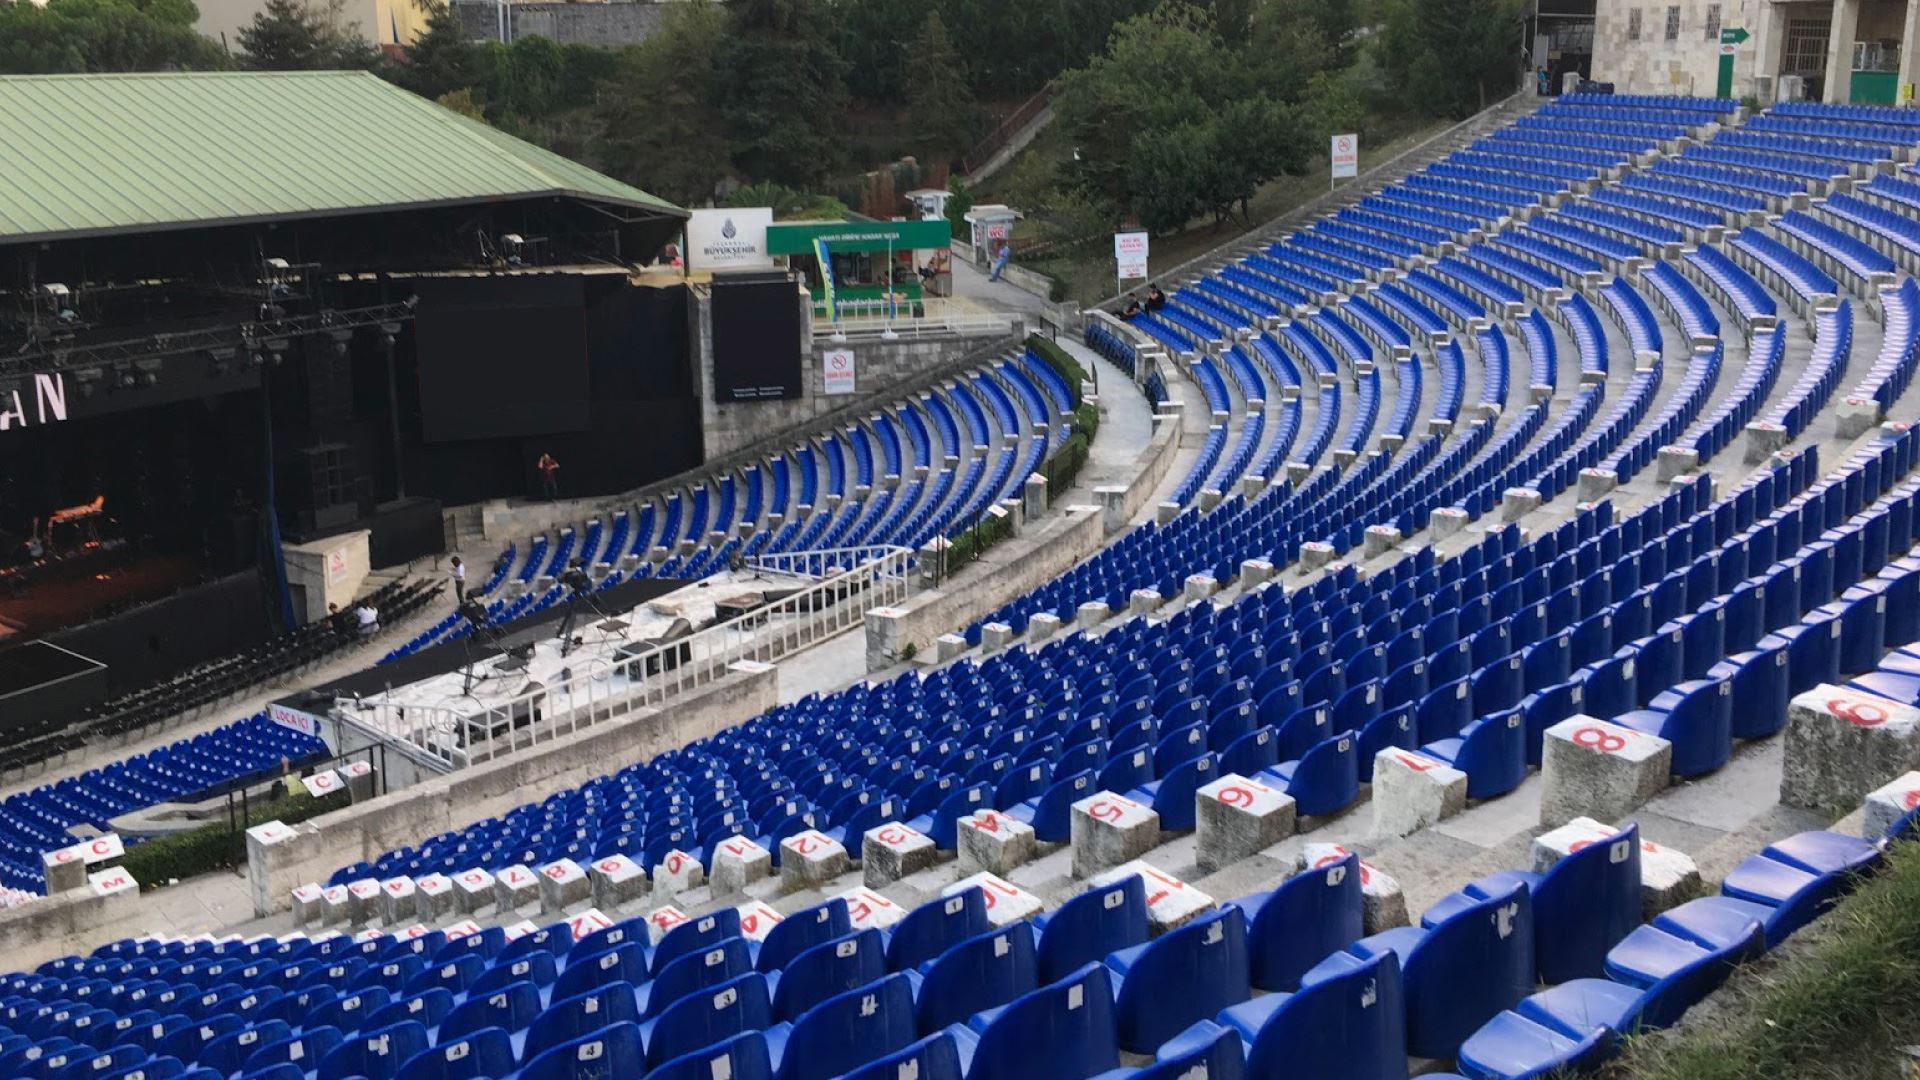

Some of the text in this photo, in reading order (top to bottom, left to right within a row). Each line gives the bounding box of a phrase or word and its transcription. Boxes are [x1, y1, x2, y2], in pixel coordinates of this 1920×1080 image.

[275, 709, 296, 727] LOCA
[314, 776, 332, 789] C
[92, 841, 110, 855] C
[1617, 845, 1624, 858] 1
[544, 864, 566, 881] 8
[1334, 870, 1340, 881] 1
[1111, 893, 1117, 904] 1
[844, 943, 852, 954] 2
[712, 953, 719, 963] 2
[453, 1046, 462, 1056] 4
[585, 1045, 595, 1056] 4
